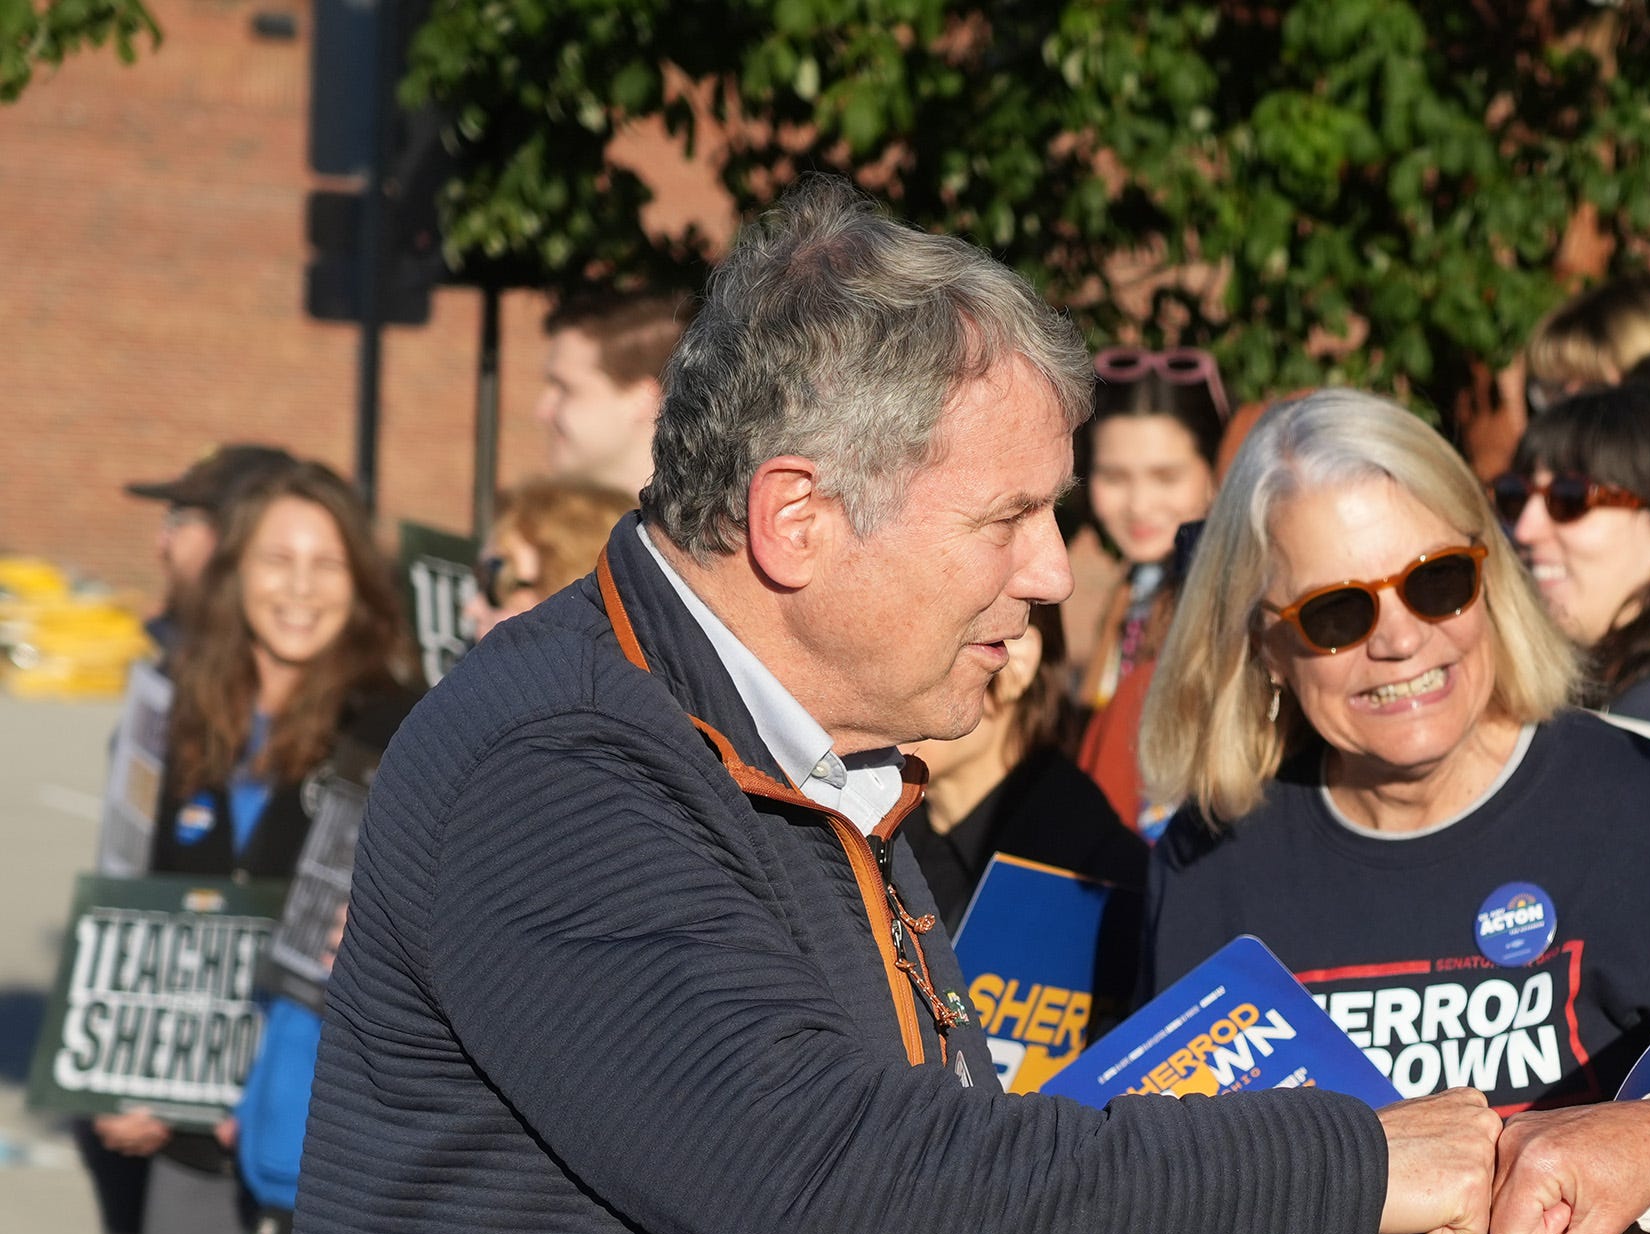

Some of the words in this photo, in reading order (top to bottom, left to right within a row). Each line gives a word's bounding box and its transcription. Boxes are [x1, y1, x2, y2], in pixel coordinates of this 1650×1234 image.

[1480, 902, 1544, 936] ACTON
[1436, 954, 1495, 972] SENATO
[1312, 971, 1553, 1049] ERROD
